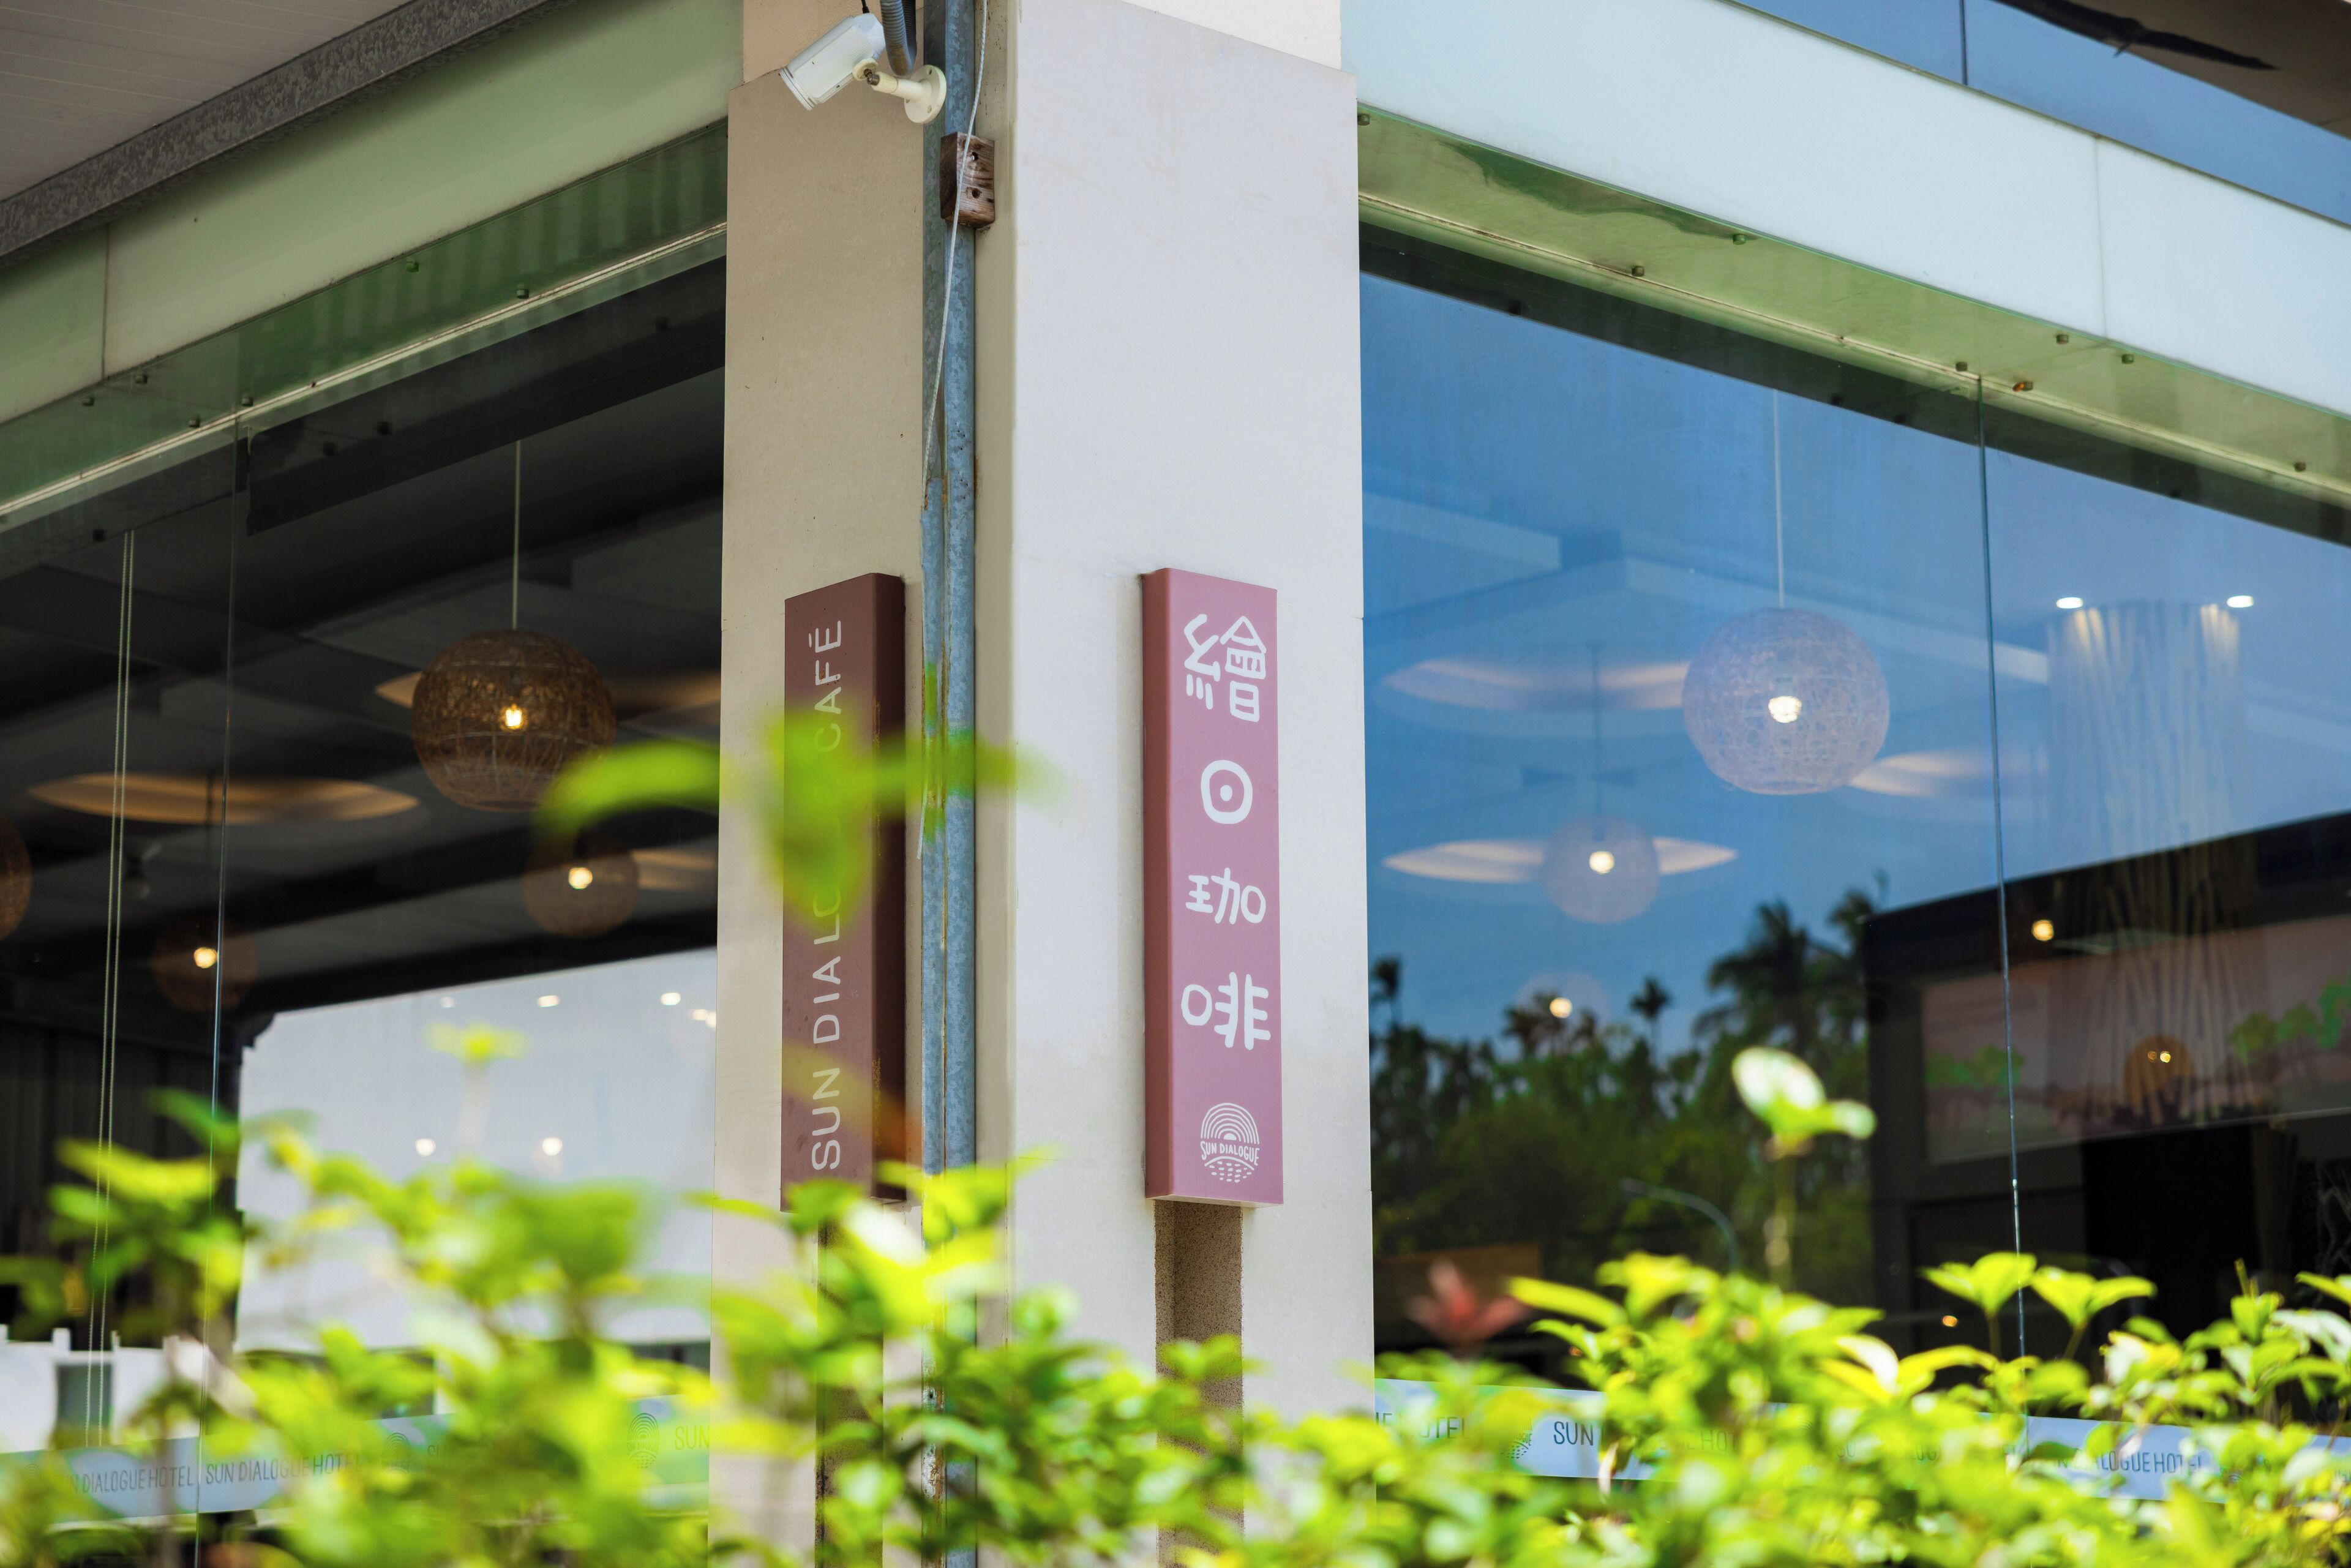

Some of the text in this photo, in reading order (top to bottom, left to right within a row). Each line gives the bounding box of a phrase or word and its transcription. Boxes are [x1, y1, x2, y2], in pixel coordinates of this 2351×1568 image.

[808, 619, 842, 1170] SUN DIALO CAFÉ
[1200, 1141, 1261, 1166] SUN DIALOGUE
[674, 1424, 710, 1451] SUN
[1553, 1420, 1594, 1447] SUN
[83, 1469, 146, 1494] DIALOGUE
[148, 1465, 195, 1488] HOTEL
[205, 1462, 234, 1485] SUN
[238, 1458, 310, 1483] DIALOGUE
